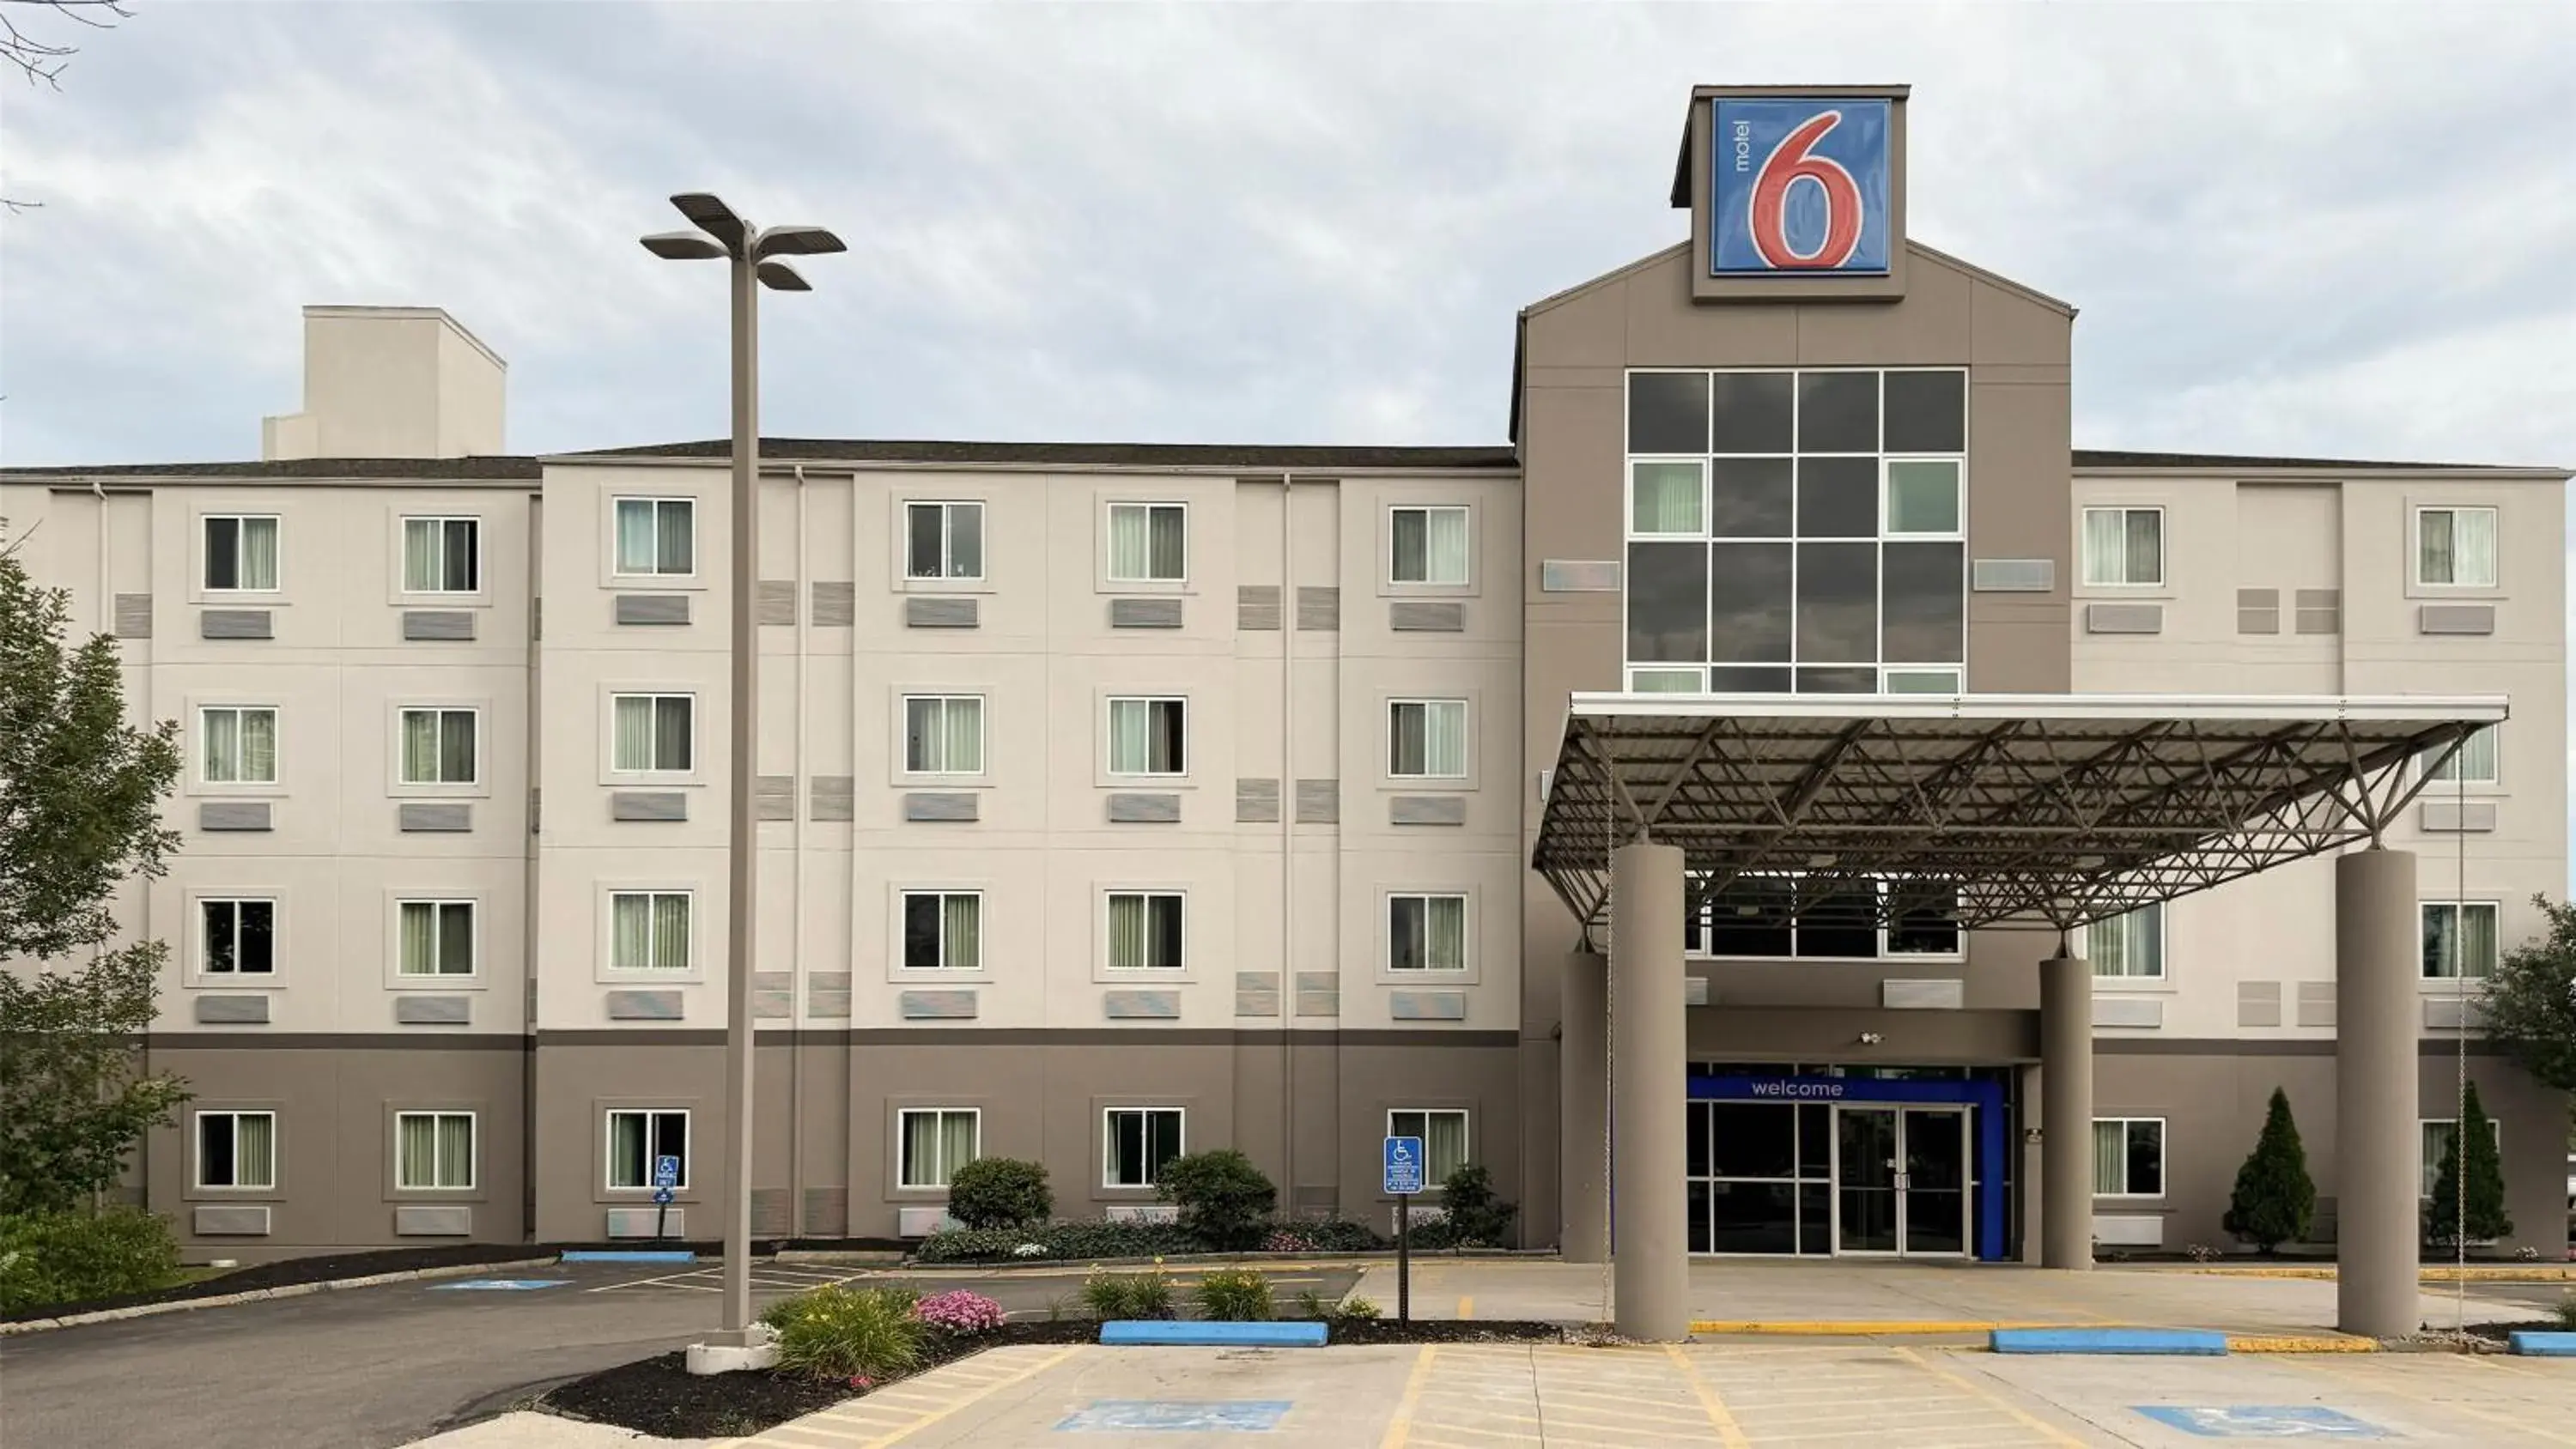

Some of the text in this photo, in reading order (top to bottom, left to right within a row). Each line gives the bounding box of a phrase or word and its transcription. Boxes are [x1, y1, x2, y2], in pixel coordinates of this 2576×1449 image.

[1732, 121, 1750, 172] motel
[1748, 110, 1863, 269] 6
[1752, 1079, 1844, 1097] welcome
